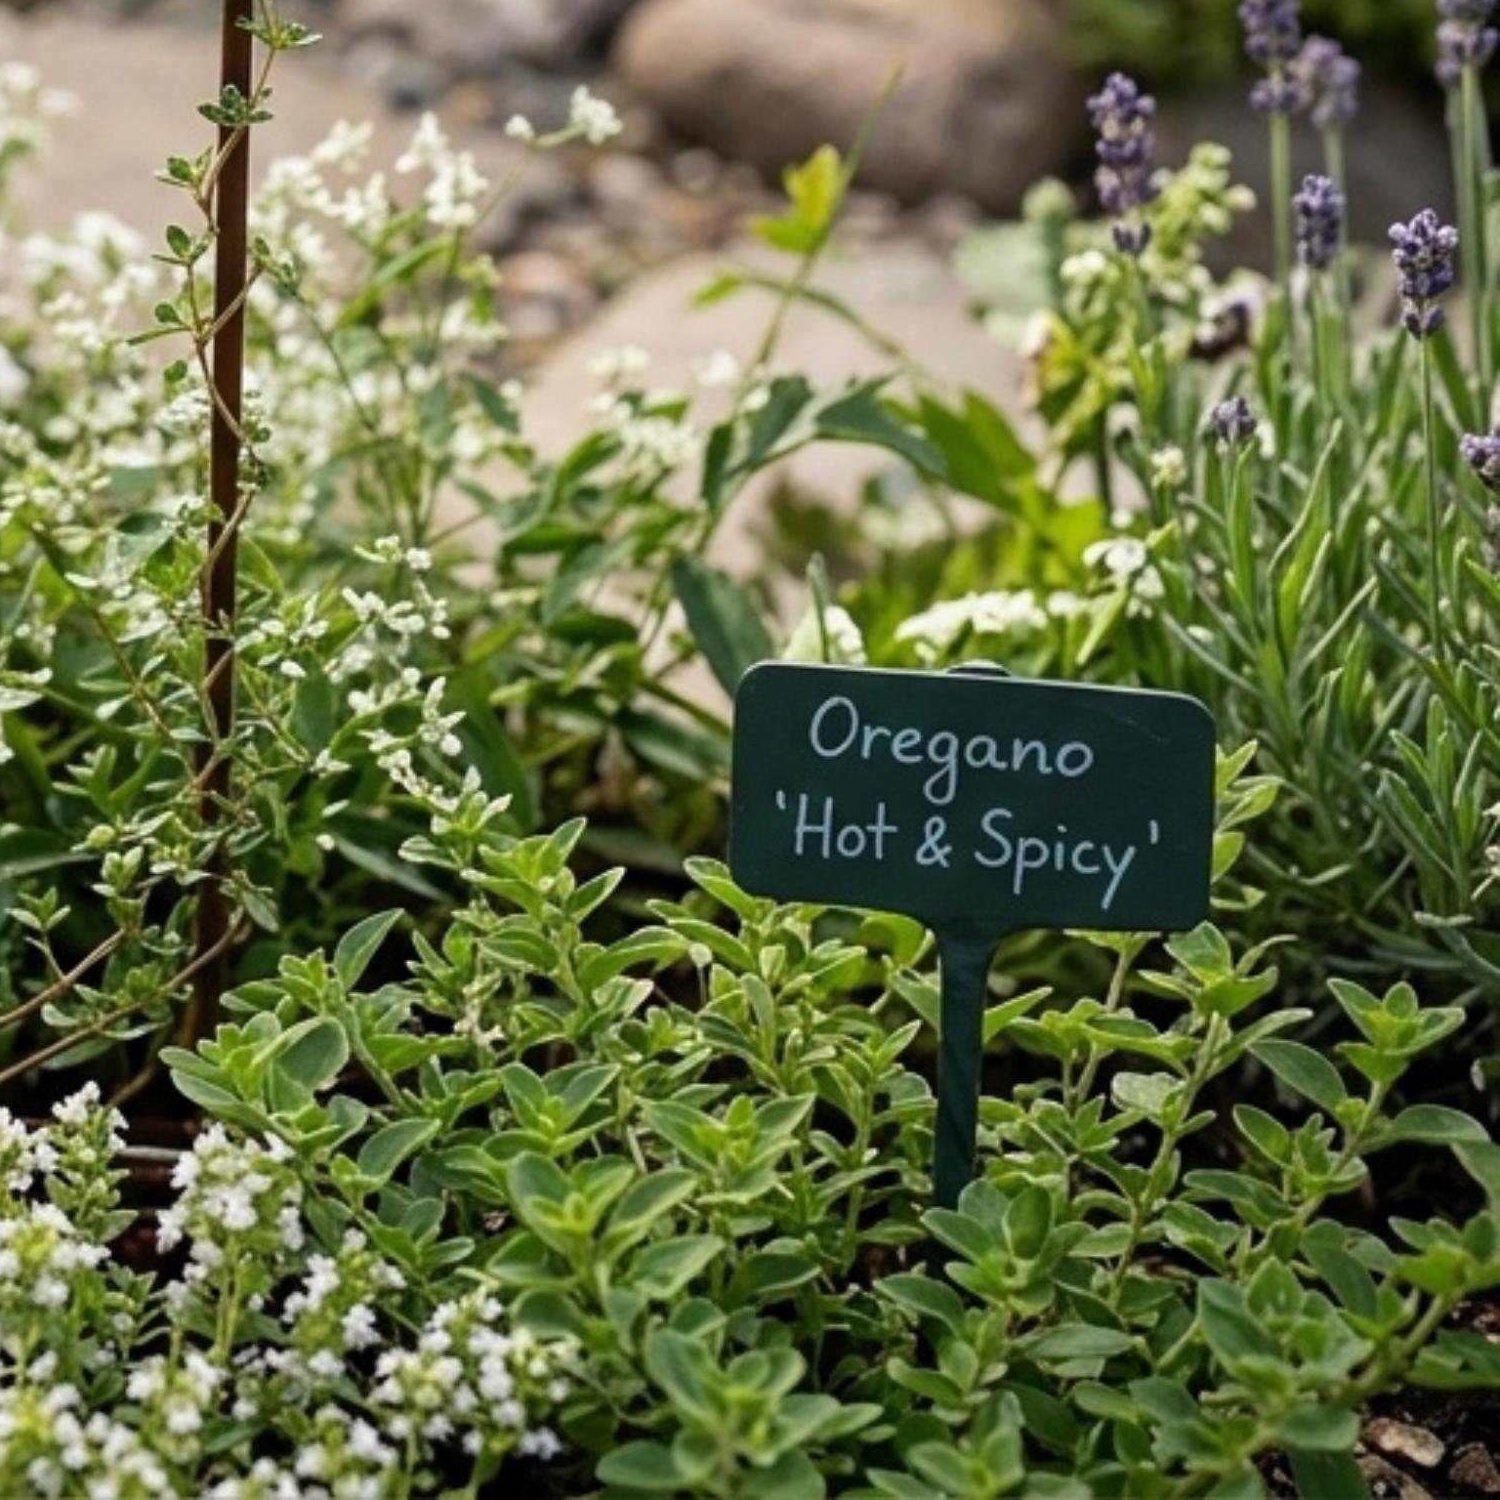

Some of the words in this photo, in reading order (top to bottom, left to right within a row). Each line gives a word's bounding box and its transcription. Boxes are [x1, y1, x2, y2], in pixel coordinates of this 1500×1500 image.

[809, 695, 1095, 804] Oregano
[775, 789, 898, 860] 'Hot
[915, 815, 953, 868] &
[974, 807, 1159, 911] Spicy'
